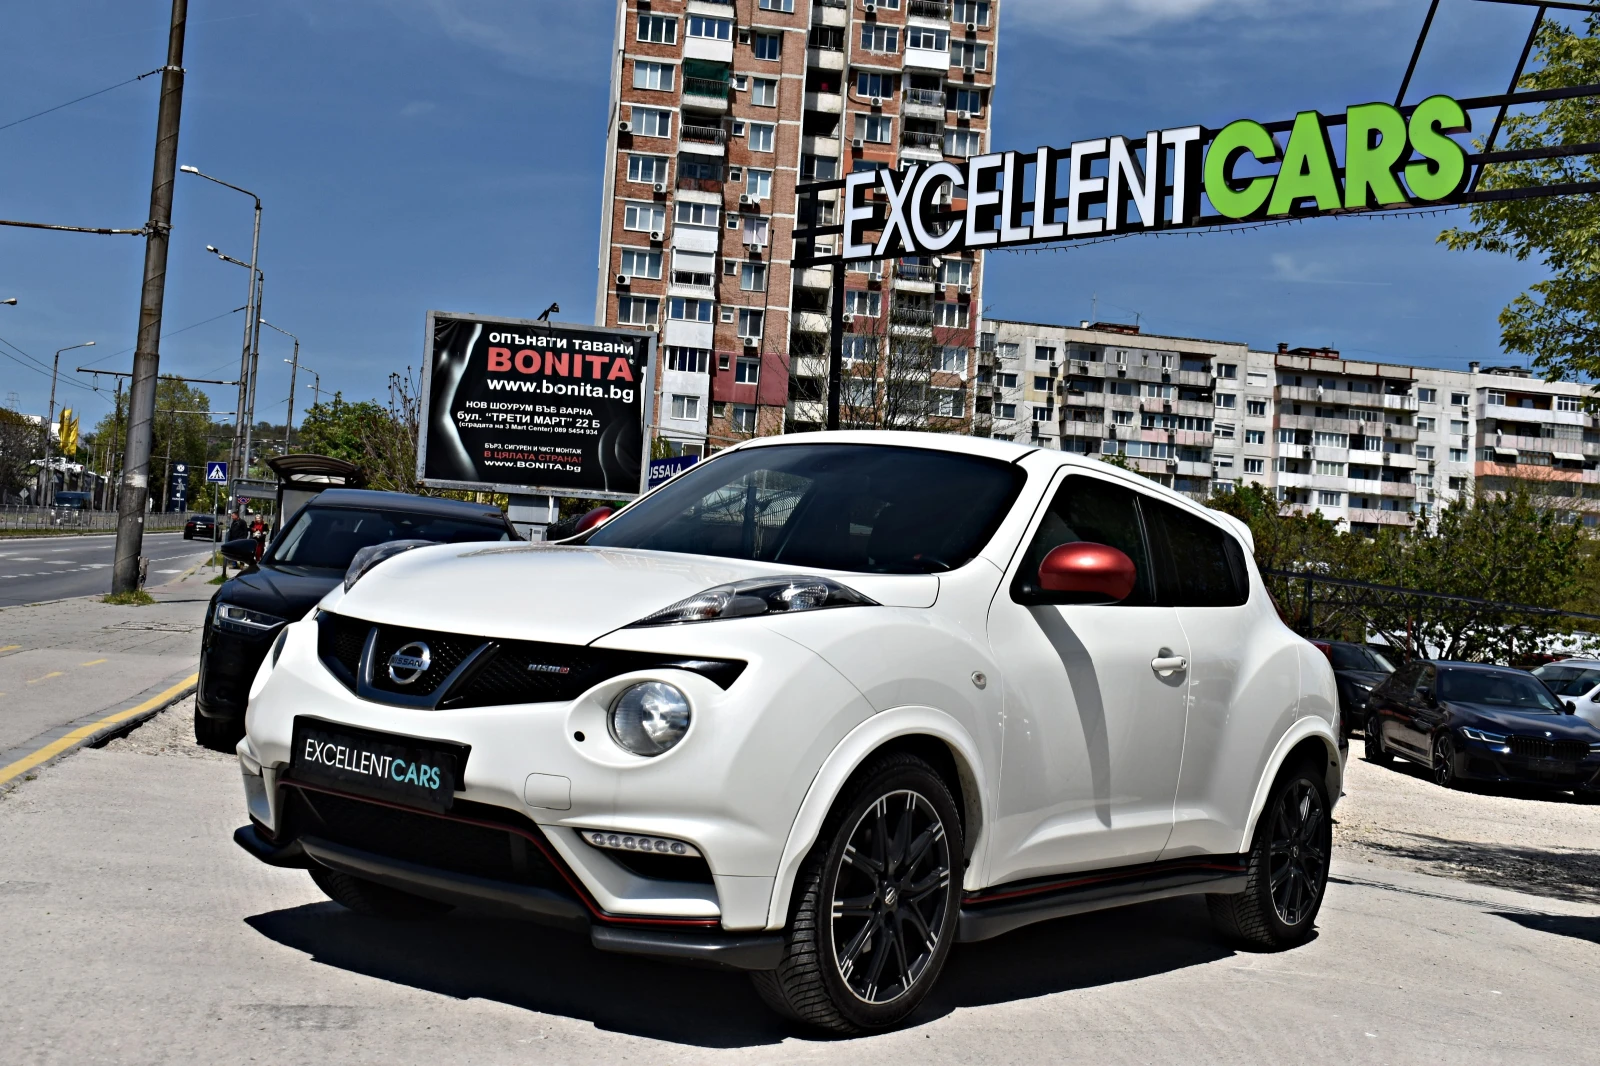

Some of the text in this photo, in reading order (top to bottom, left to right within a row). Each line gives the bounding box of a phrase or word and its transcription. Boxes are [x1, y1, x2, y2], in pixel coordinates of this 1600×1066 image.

[488, 332, 634, 355] опънати тавани
[487, 347, 634, 381] BONITA
[486, 378, 634, 403] www.bonita.bg
[466, 400, 488, 409] НОВ
[489, 402, 533, 412] ШОУРУМ
[560, 407, 593, 416] ВАРНА
[457, 411, 482, 421] бул.
[575, 418, 589, 428] 22
[592, 419, 601, 428] Б
[484, 450, 492, 458] В
[494, 451, 536, 461] ЦЯЛАТА
[484, 460, 582, 473] www.BONITA.bg
[391, 656, 424, 668] NISSAN
